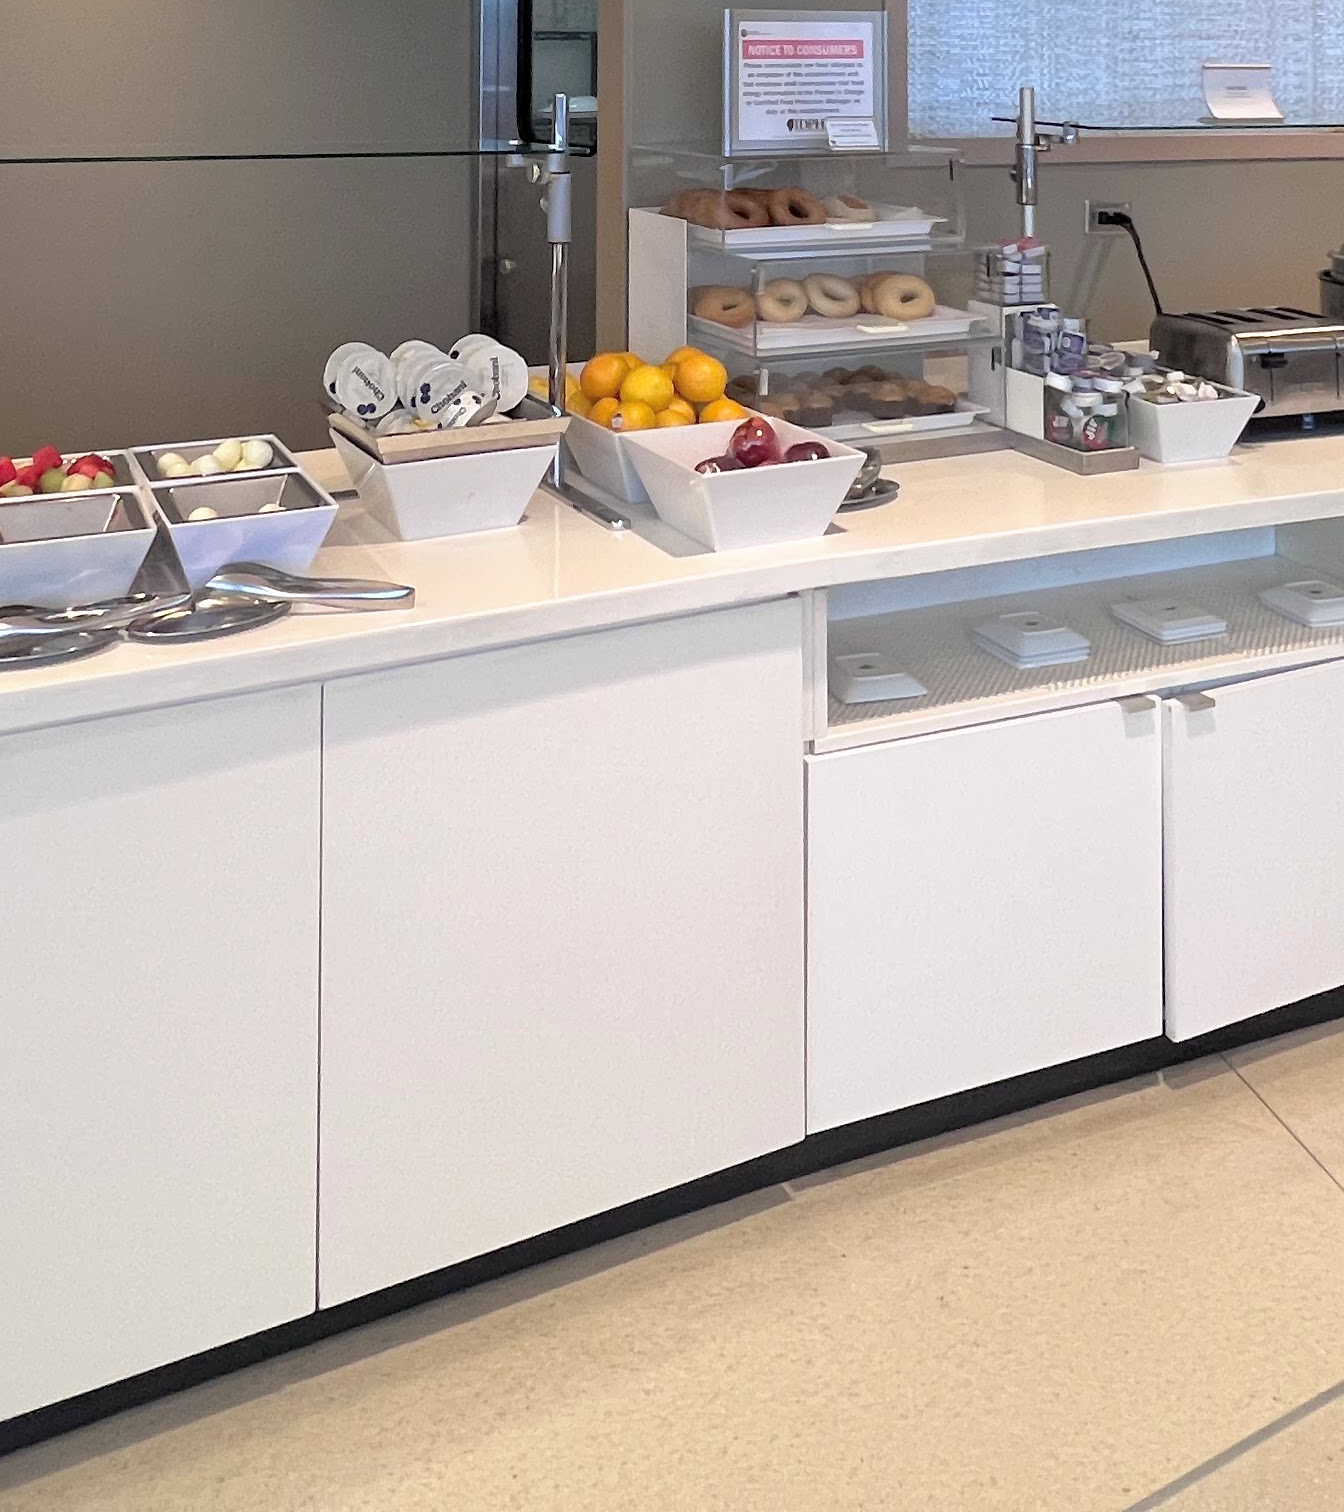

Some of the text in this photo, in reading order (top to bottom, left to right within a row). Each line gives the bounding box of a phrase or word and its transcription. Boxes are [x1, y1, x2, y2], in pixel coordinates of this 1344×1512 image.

[748, 43, 858, 56] NOTICE TO CONSUMERS
[351, 365, 385, 401] Chobani
[430, 379, 468, 414] Chobani
